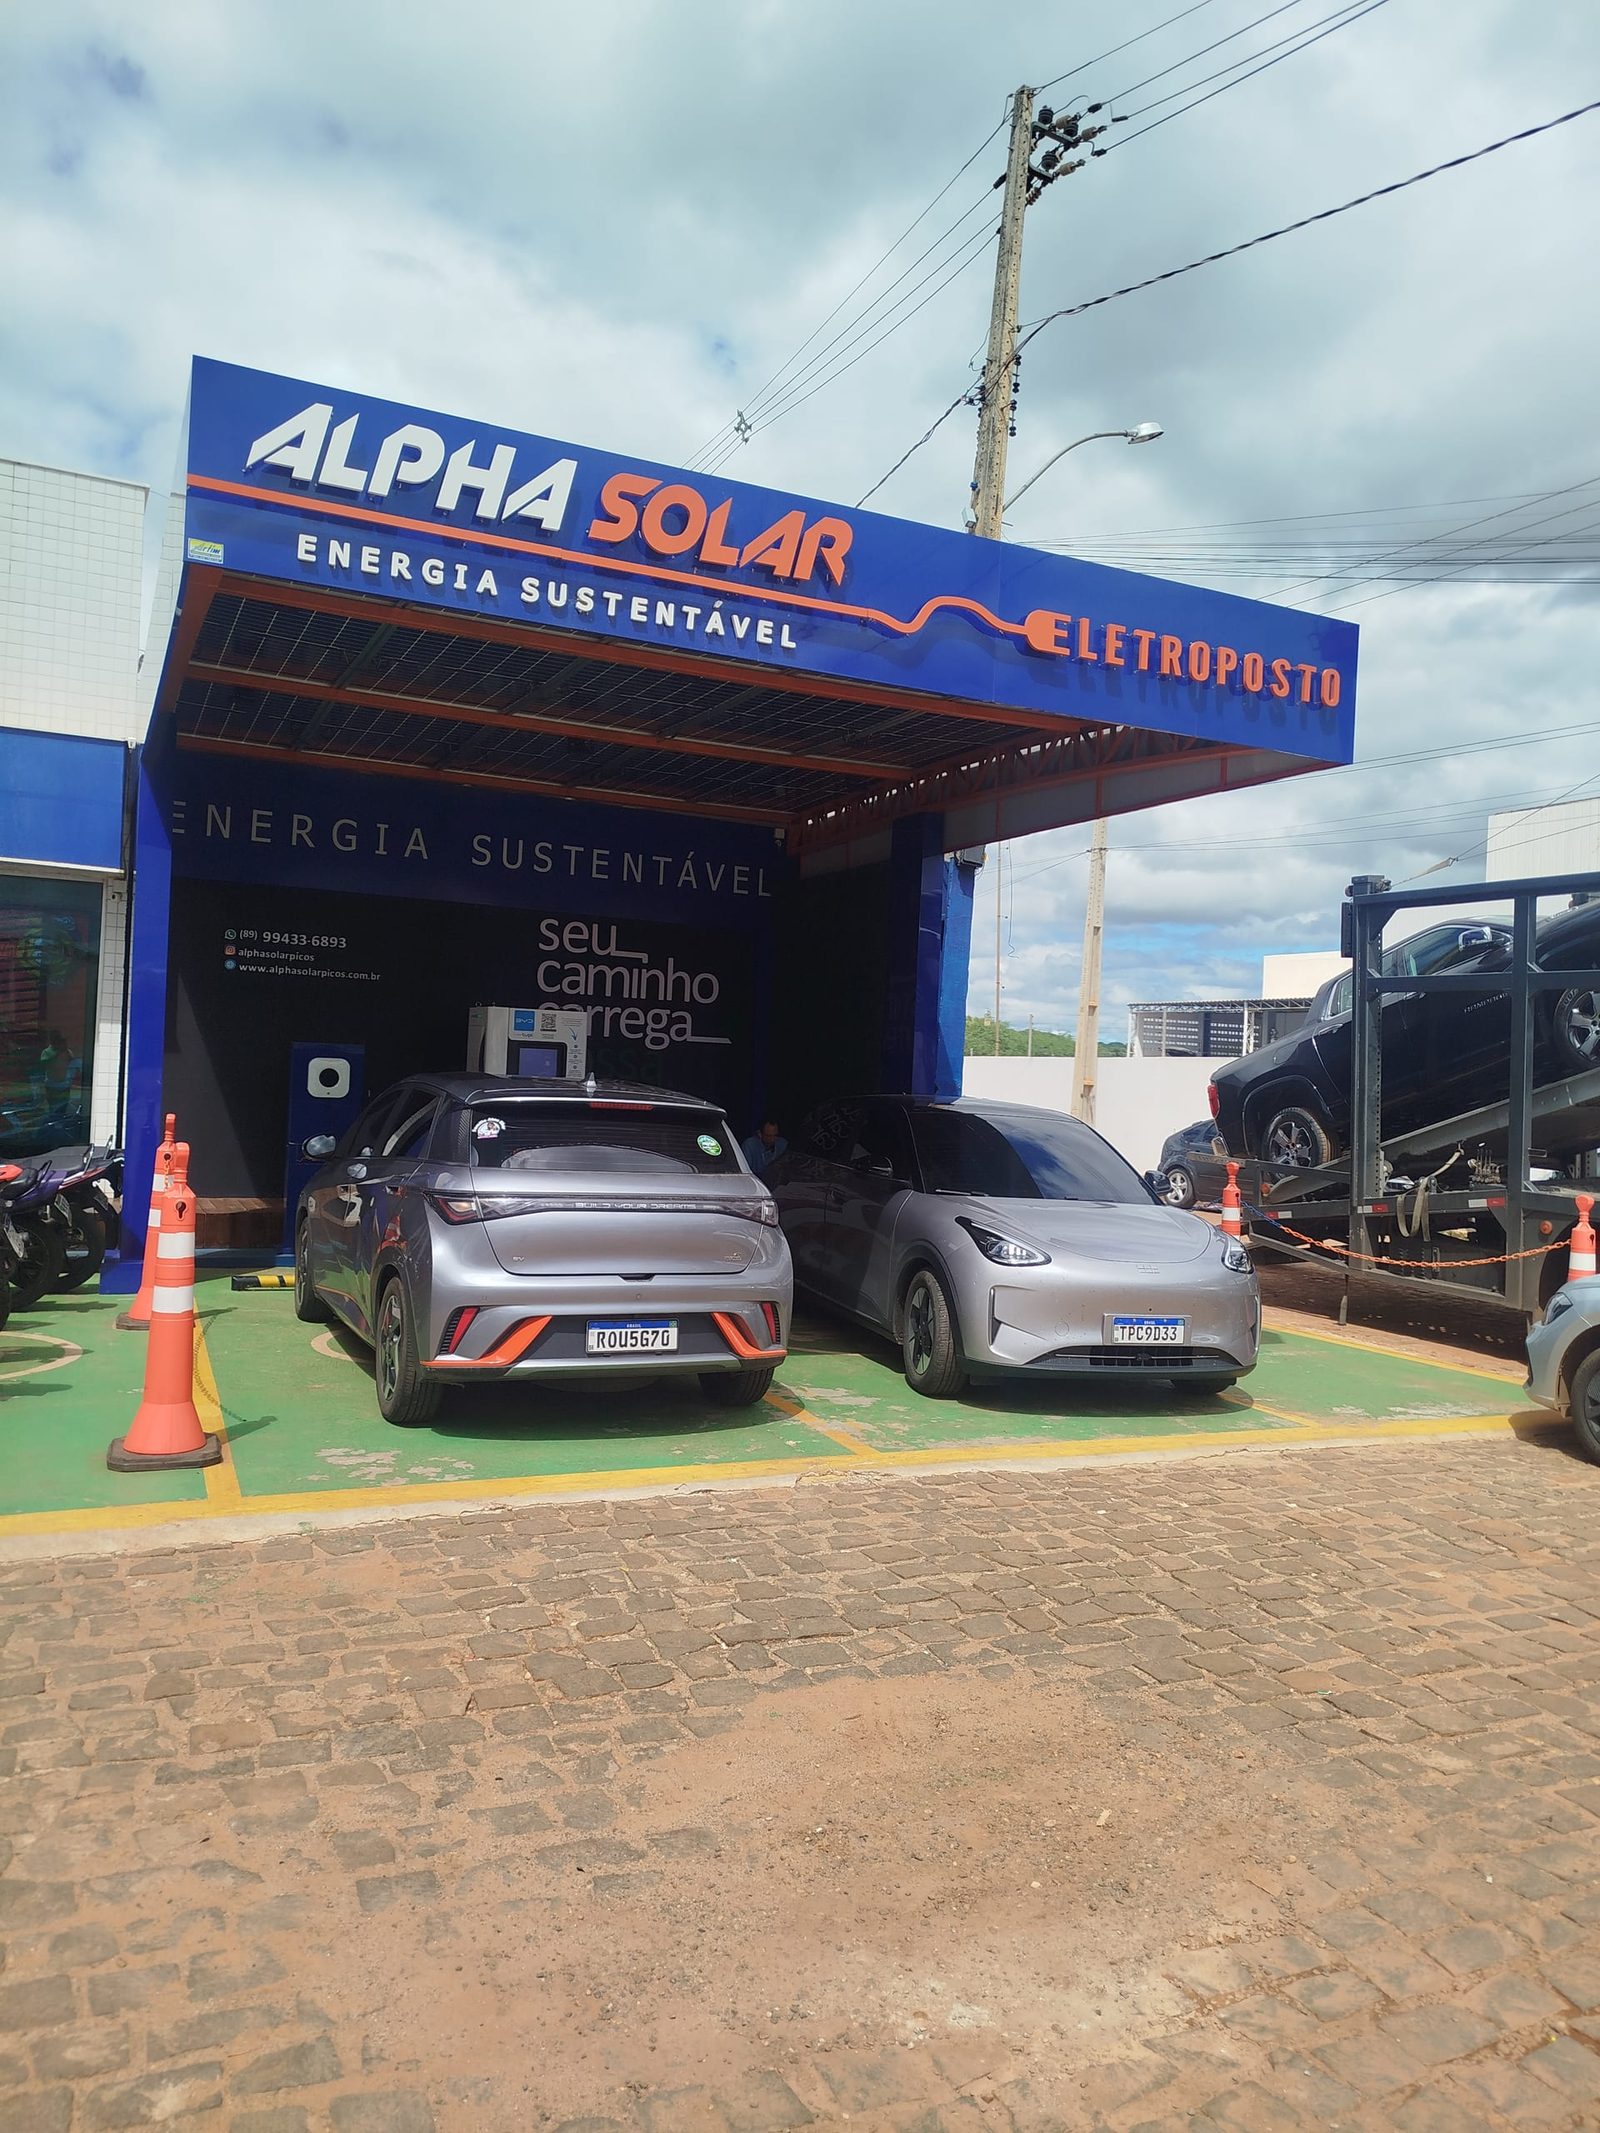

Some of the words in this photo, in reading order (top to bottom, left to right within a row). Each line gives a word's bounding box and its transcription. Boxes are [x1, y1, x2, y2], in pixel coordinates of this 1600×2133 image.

[243, 402, 577, 531] ALPHA
[588, 472, 853, 587] SOLAR
[297, 533, 499, 597] ENERGIA
[520, 577, 797, 649] SUSTENTÁVEL
[1046, 613, 1341, 707] ELETROPOSTO
[471, 834, 772, 897] SUSTENTÁVEL
[238, 948, 315, 962] alphasolarpicos
[239, 930, 258, 940] (89)
[262, 931, 347, 949] 99433-6893
[538, 919, 649, 963] seu
[239, 963, 381, 981] www.alphasolarpicos.com.br
[537, 957, 720, 1004] caminho
[597, 1330, 670, 1348] ROU5G70
[1120, 1326, 1177, 1341] TPC9D33
